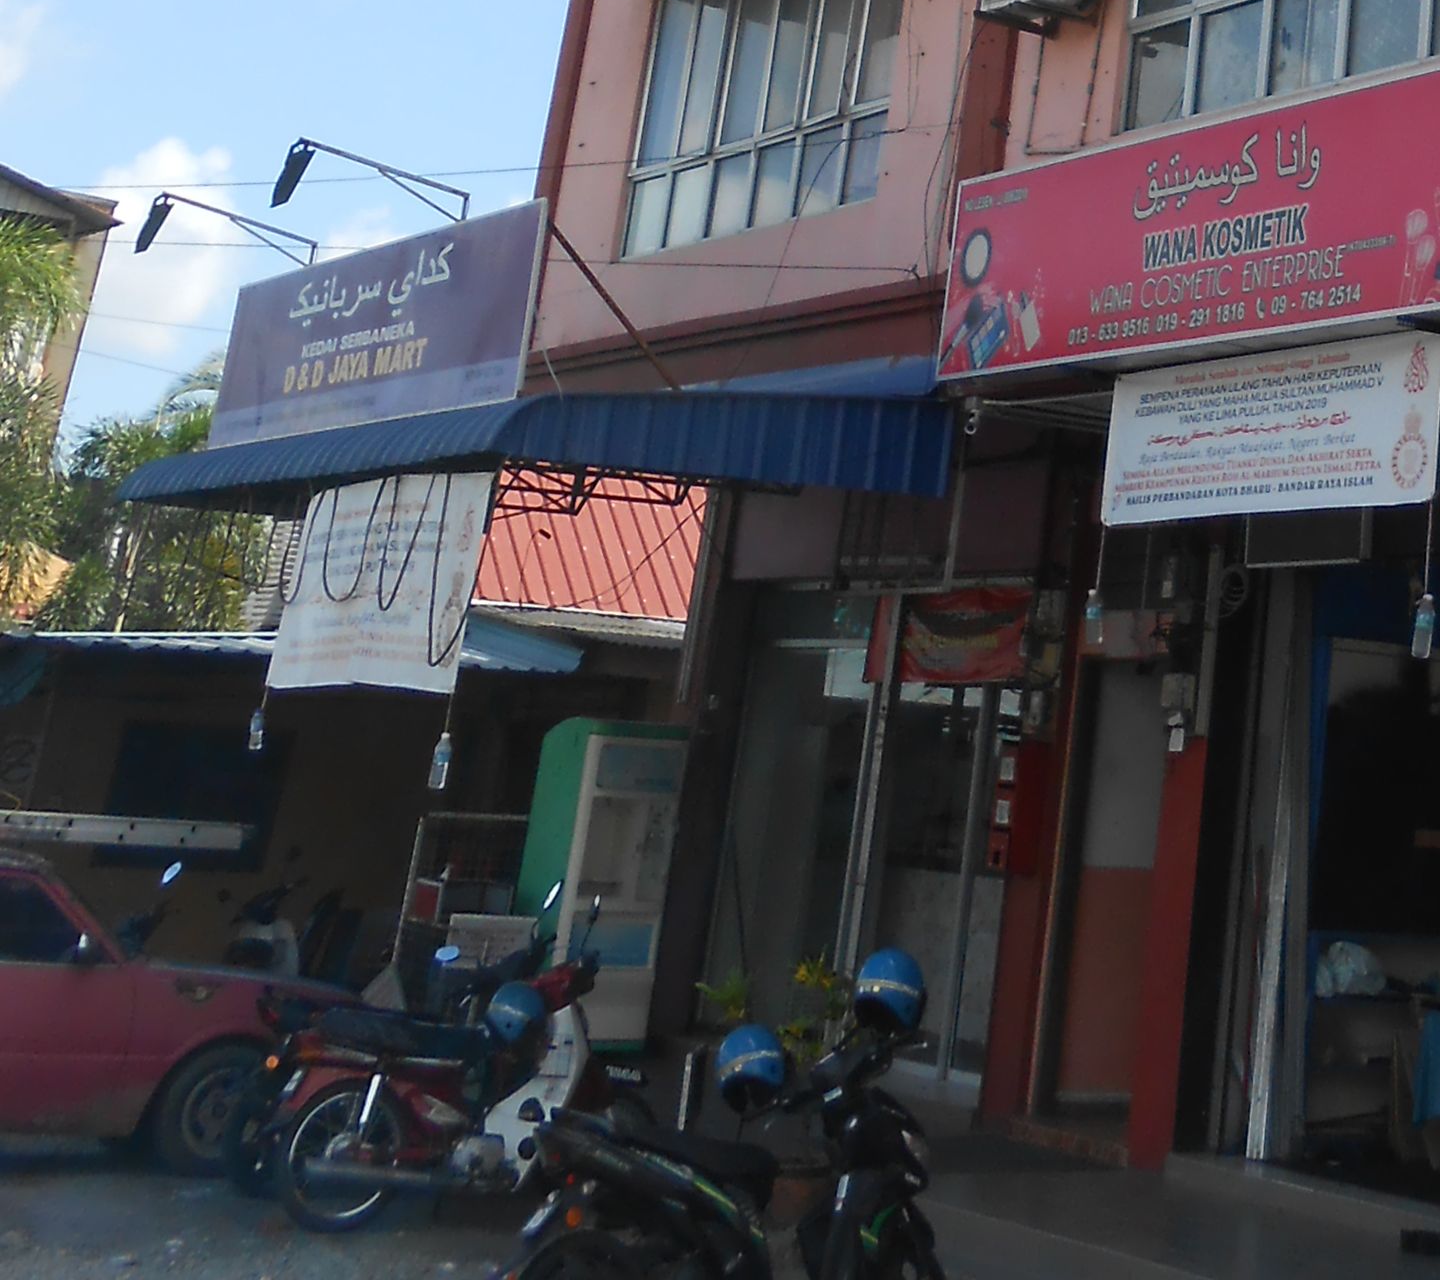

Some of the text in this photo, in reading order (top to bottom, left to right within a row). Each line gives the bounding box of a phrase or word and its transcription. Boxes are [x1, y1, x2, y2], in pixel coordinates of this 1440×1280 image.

[1133, 120, 1320, 222] وانا كوسميتيق
[1143, 203, 1310, 272] WANA KOSMETIK
[1090, 244, 1346, 315] WANA COSMETIC ENTERPRISE
[1068, 326, 1088, 345] 013
[1121, 316, 1150, 339] 9516
[1156, 310, 1178, 333] 019
[1189, 306, 1211, 328] 291
[1216, 301, 1245, 323] 1816
[1271, 295, 1287, 316] 09
[1301, 289, 1324, 312] 764
[1327, 283, 1361, 306] 2514
[301, 320, 415, 359] KEDAI SERBANEKA
[283, 338, 429, 394] D & D JAYA MART
[1140, 362, 1383, 405] SEMPENA PERAYAAN ULANG TAHUN HARI KEPUTERAAN
[1135, 375, 1385, 418] KEBAWAH DULI YANG MAHA MULIA SULTAN MUHAMMAD V
[1179, 413, 1201, 425] YANG
[1203, 410, 1215, 423] KE
[1216, 407, 1237, 421] LIMA
[1272, 399, 1303, 413] TAHUN
[1304, 396, 1328, 410] 2019
[1343, 475, 1374, 487] ISLAM
